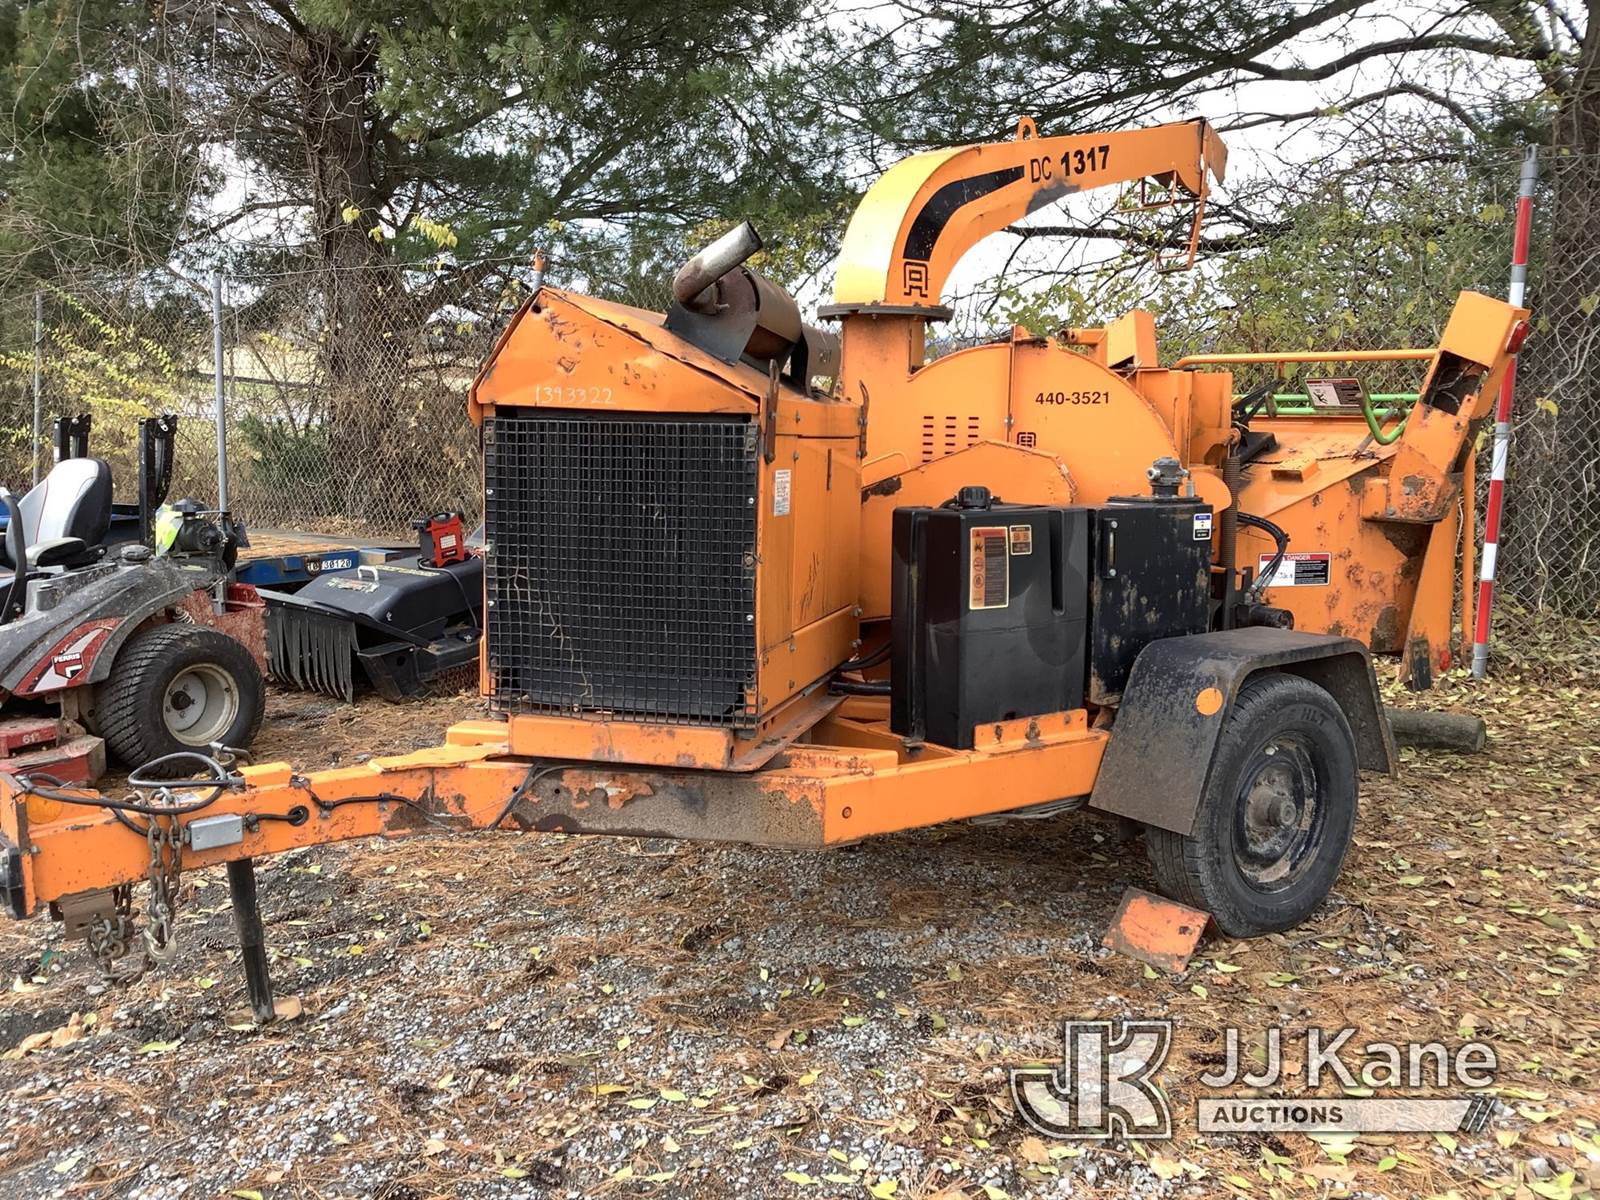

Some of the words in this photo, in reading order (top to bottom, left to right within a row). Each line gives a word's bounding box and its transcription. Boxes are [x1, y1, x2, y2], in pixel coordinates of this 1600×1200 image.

[1030, 156, 1052, 183] DC
[1061, 145, 1110, 177] 1317
[535, 384, 616, 405] 1393322
[1035, 391, 1109, 405] 440-3521
[53, 652, 81, 663] FERRIS
